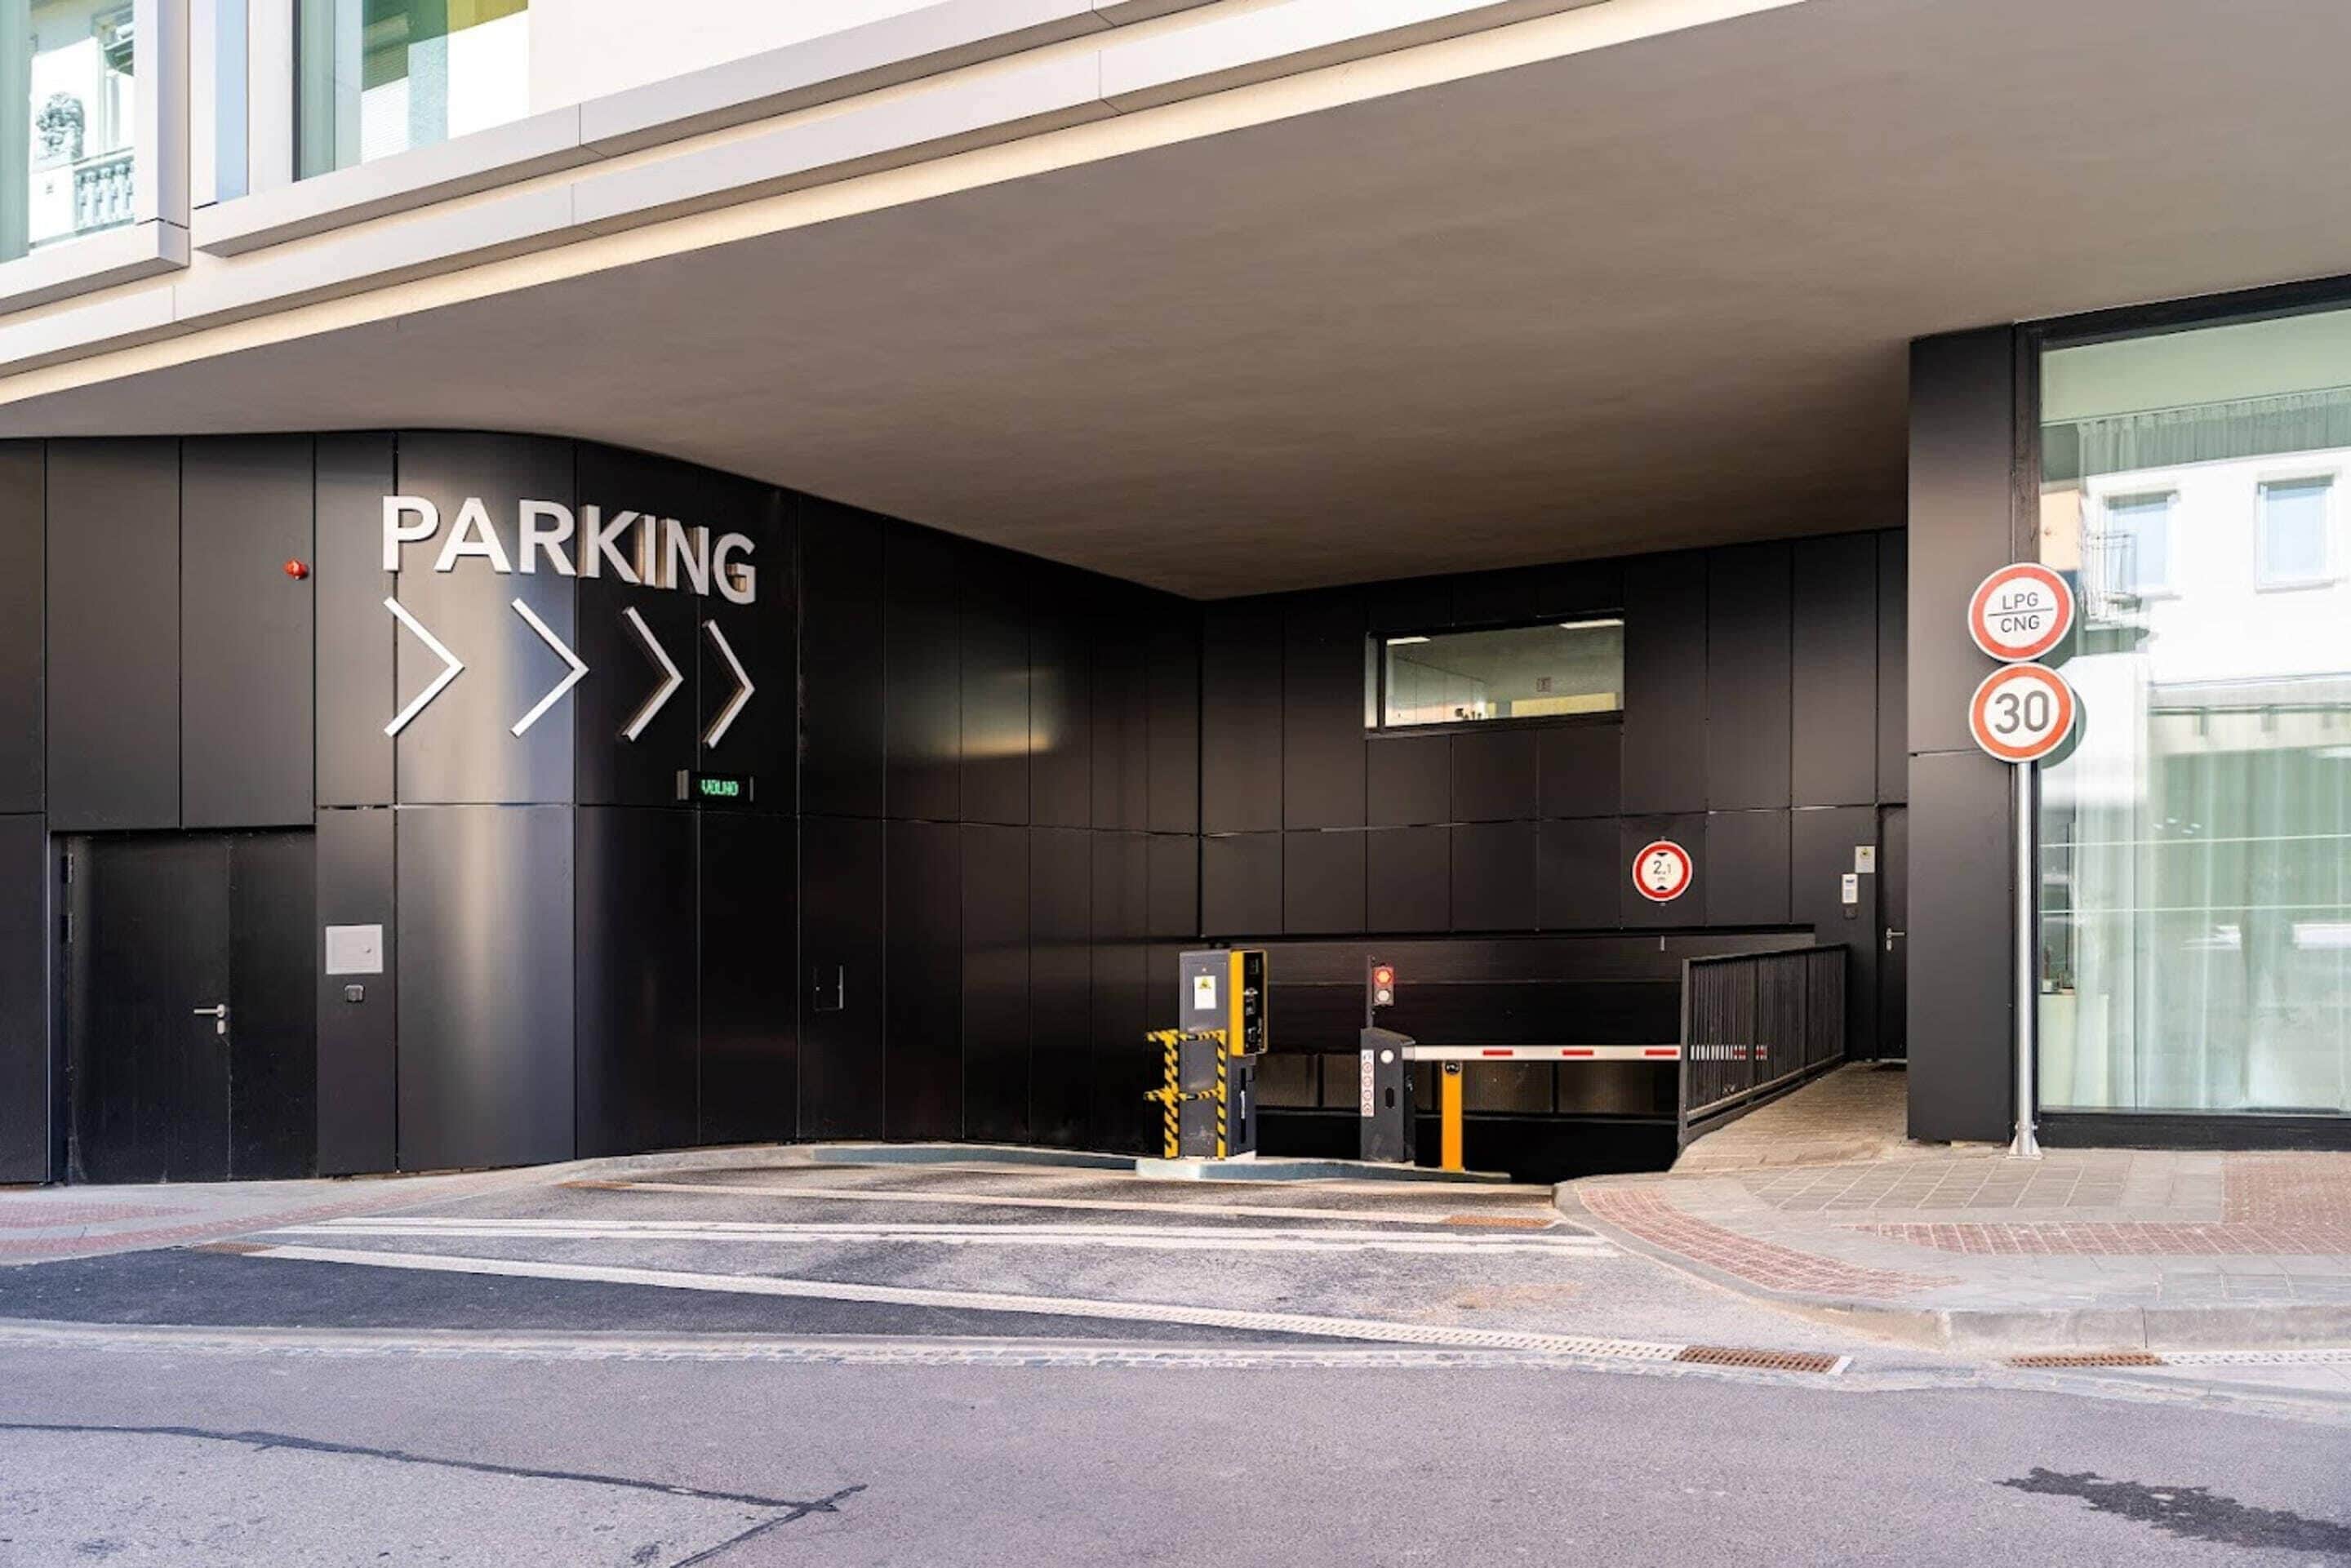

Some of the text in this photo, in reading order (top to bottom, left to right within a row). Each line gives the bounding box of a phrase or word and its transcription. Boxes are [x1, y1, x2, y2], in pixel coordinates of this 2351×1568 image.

[382, 495, 756, 605] PARKING
[2002, 592, 2038, 610] LPG
[2001, 615, 2040, 633] CNG
[1995, 691, 2049, 734] 30
